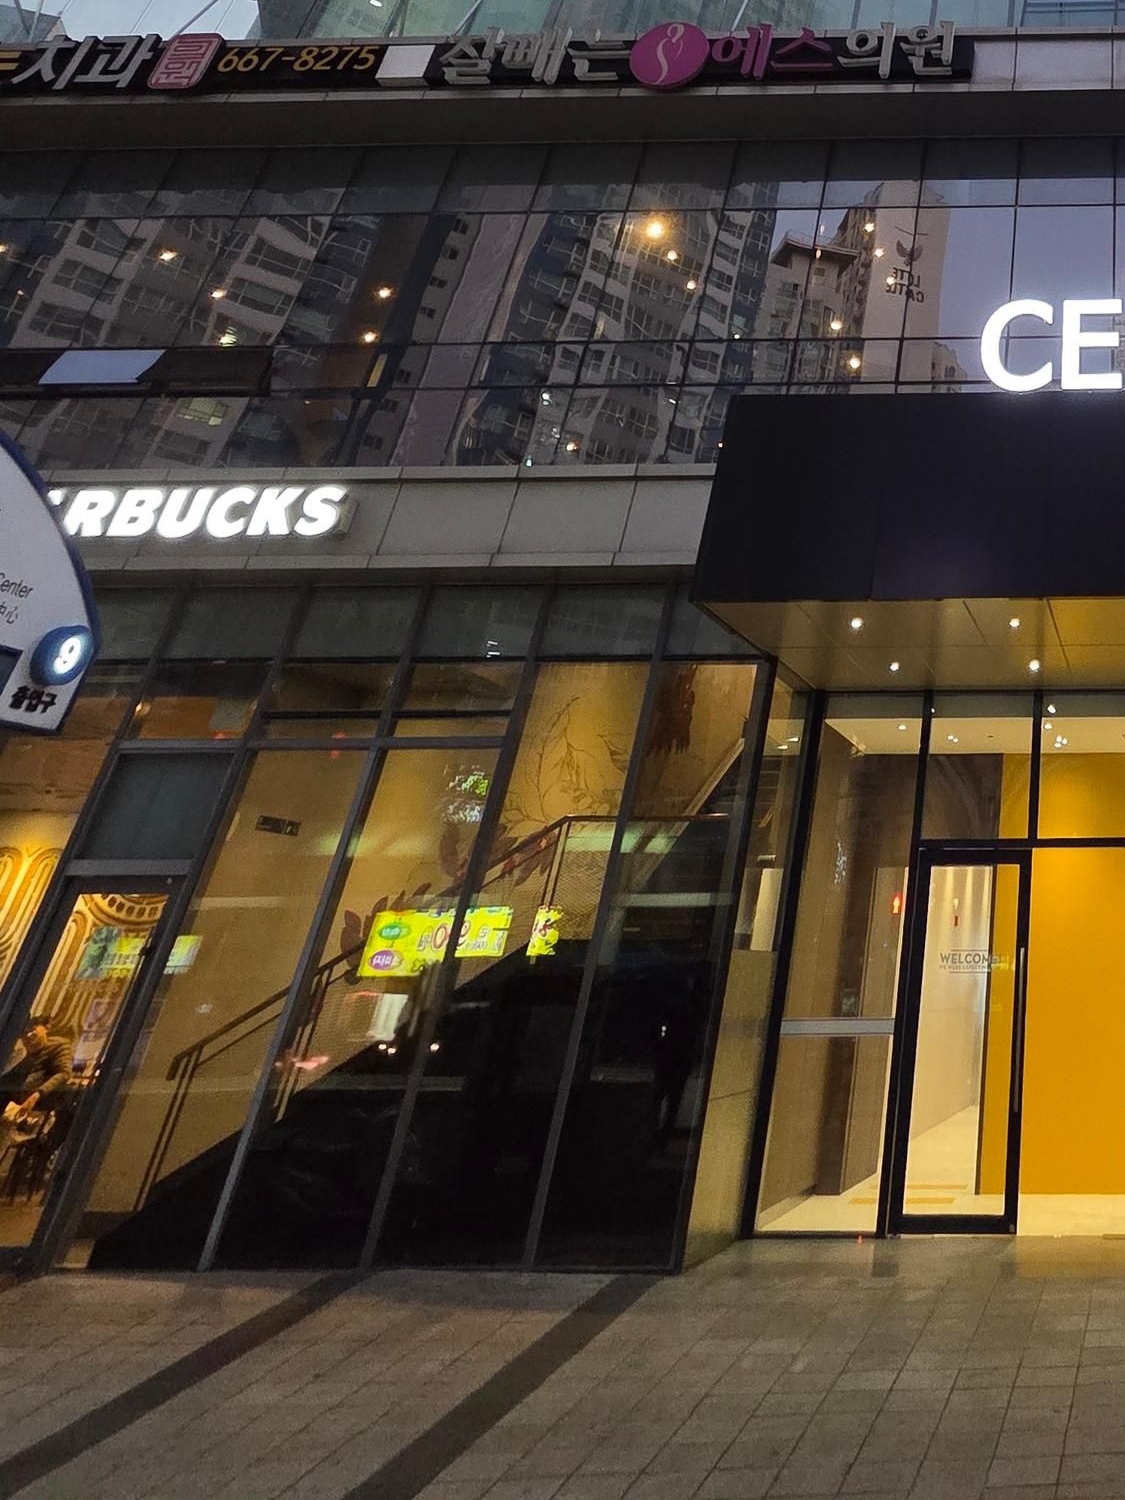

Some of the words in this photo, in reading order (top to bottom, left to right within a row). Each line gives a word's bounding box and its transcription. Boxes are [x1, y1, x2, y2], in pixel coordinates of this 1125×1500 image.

[11, 35, 154, 90] 치과
[217, 45, 382, 73] 667-8275
[53, 635, 82, 674] 9
